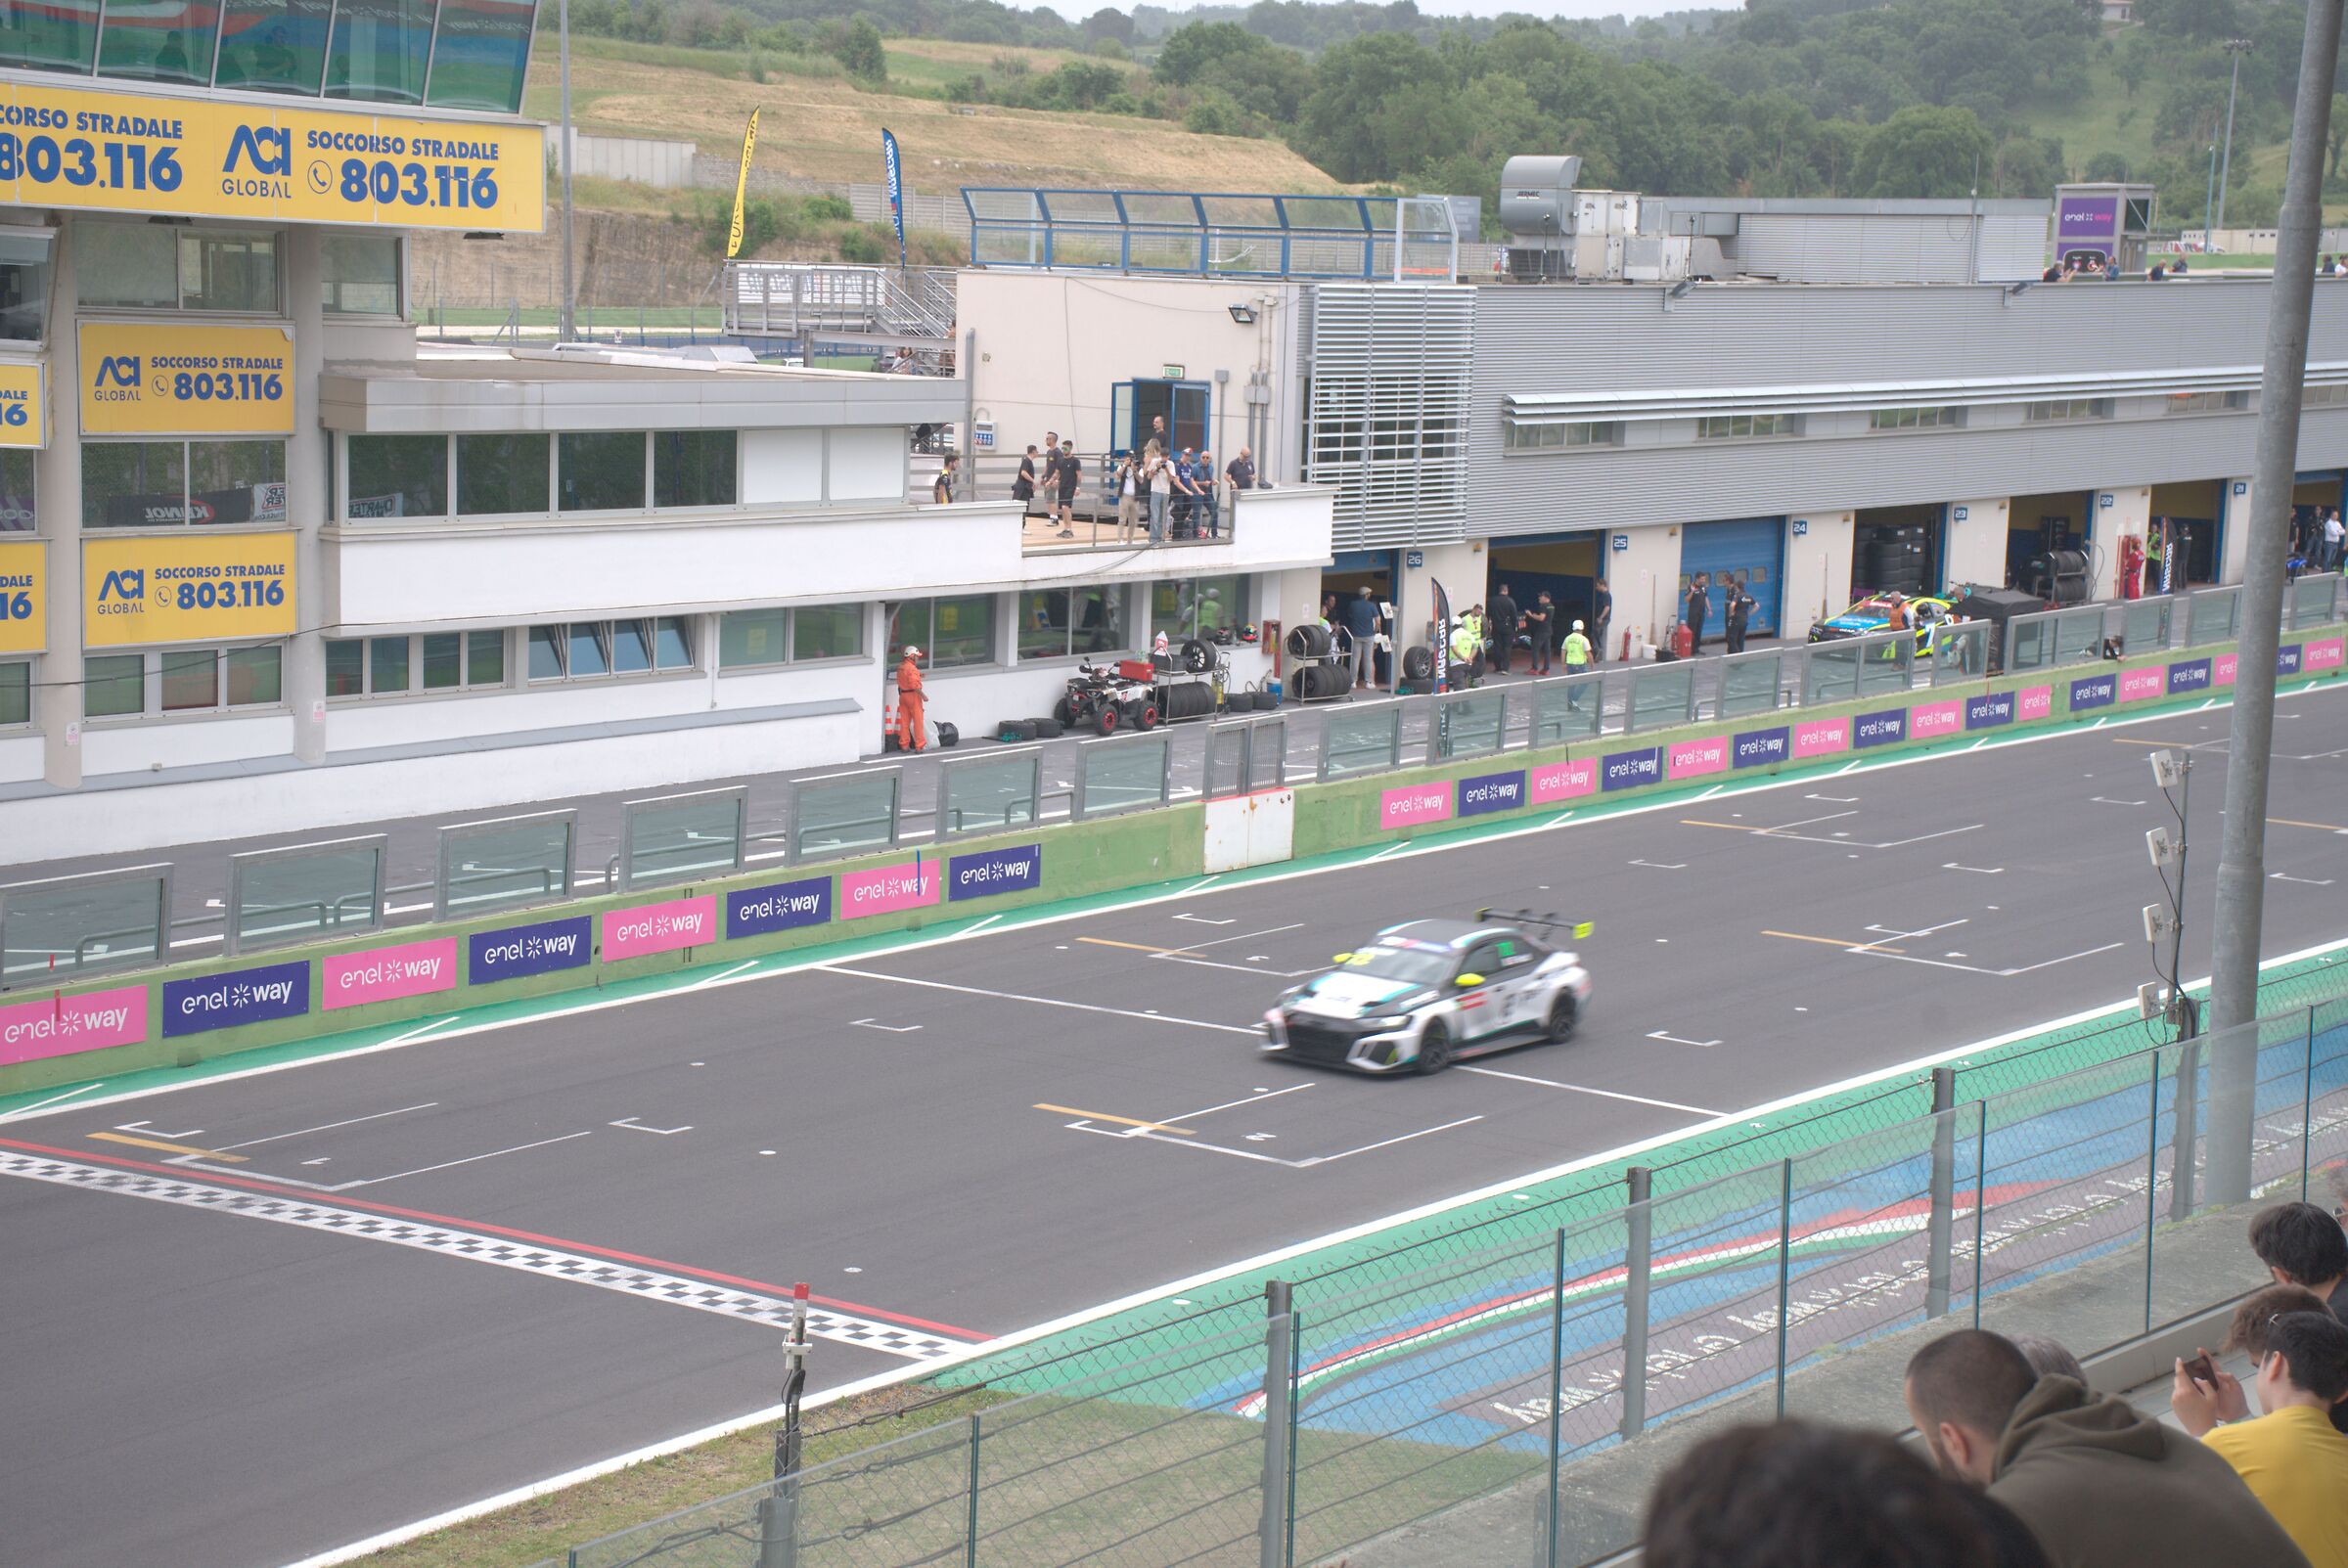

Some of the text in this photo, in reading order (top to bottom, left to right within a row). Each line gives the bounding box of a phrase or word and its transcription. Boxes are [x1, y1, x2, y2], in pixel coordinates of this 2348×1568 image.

[0, 105, 182, 139] ORSO STRADALE
[223, 125, 291, 176] ACI
[307, 130, 498, 160] SOCCORSO STRADALE
[0, 132, 182, 192] 803.116
[222, 179, 291, 199] GLOBAL
[340, 158, 497, 208] 803.116
[95, 356, 140, 386] ACI
[152, 357, 282, 369] SOCCORSO STRADALE
[0, 390, 27, 400] ALE
[95, 390, 141, 401] GLOBAL
[174, 373, 282, 400] 803.116
[1793, 523, 1806, 533] 24
[1613, 538, 1627, 548] 25
[1408, 555, 1422, 564] 26
[156, 564, 284, 579] SOCCORSO STRADALE
[99, 569, 144, 601] ACI
[177, 580, 284, 609] 803.116
[98, 603, 144, 614] GLOBAL
[1740, 739, 1783, 755] enel way
[1801, 730, 1842, 745] enel way
[1609, 758, 1656, 778] enel way
[1676, 749, 1720, 766] enel way
[1540, 772, 1588, 789] enel way
[1390, 793, 1443, 814] enel way
[1467, 784, 1517, 802] enel way
[961, 861, 1030, 884] enel way
[854, 876, 927, 901] enel way
[741, 894, 819, 920] enel way
[617, 914, 702, 941] enel way
[485, 934, 576, 963] enel way
[340, 958, 440, 988] enel way
[182, 981, 293, 1013] enel way
[5, 1008, 127, 1043] enel way
